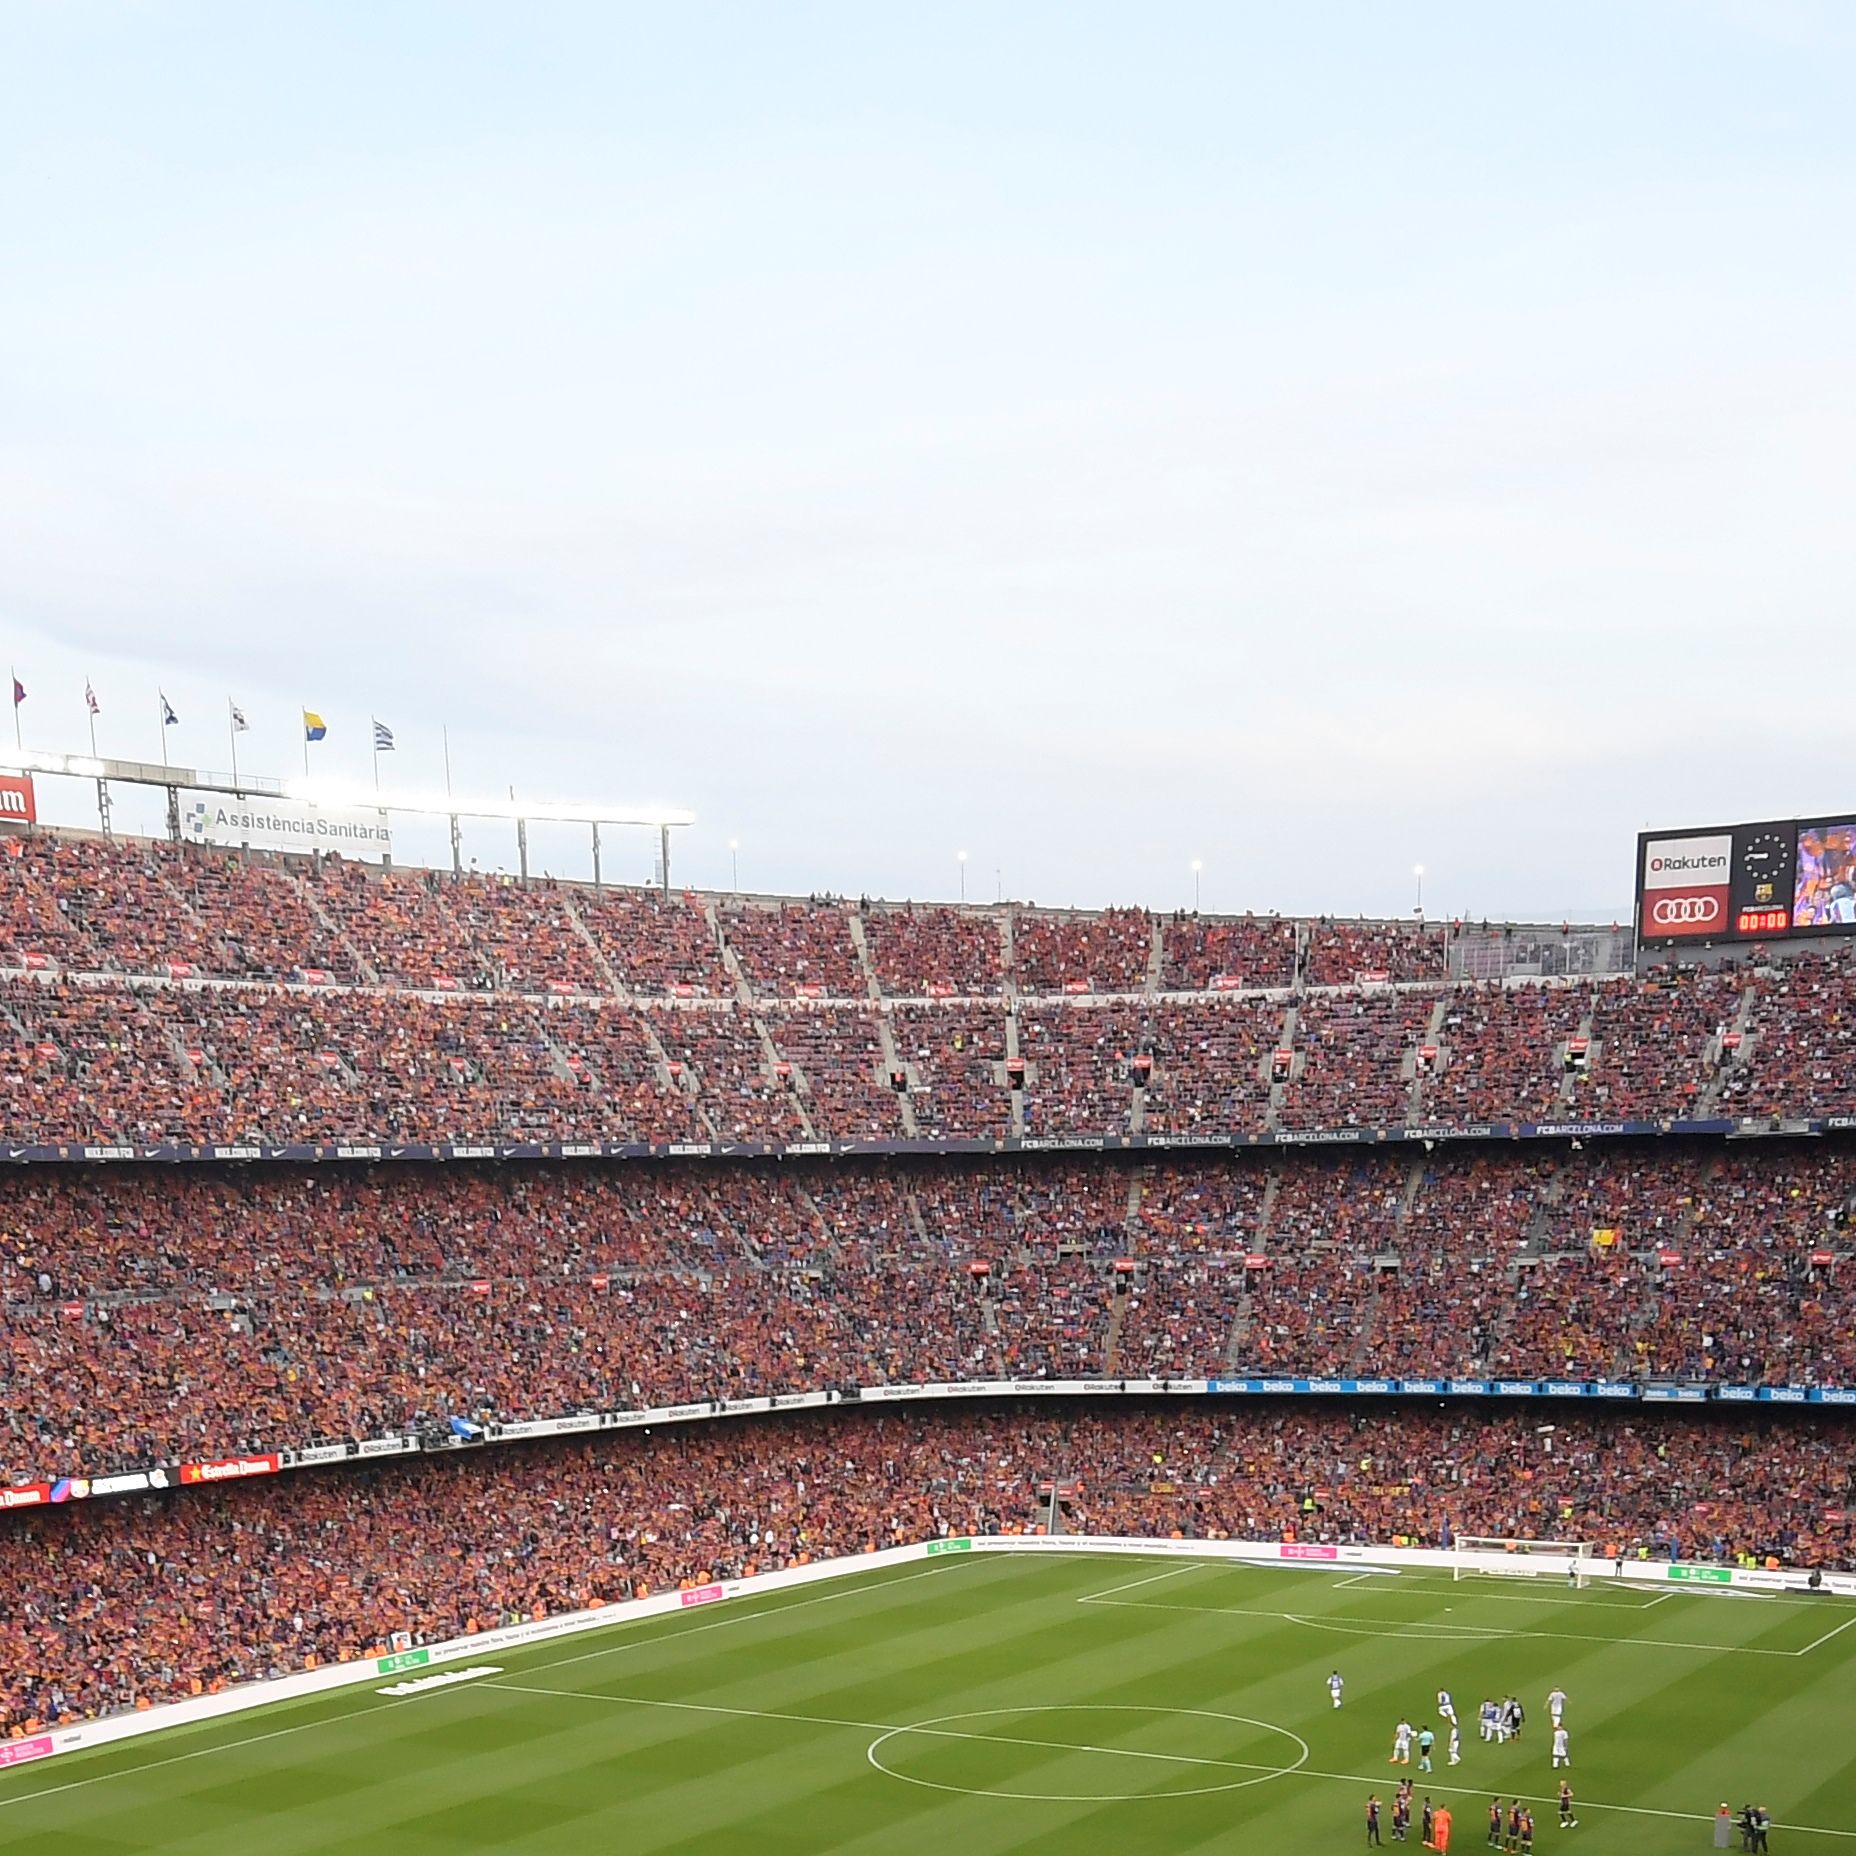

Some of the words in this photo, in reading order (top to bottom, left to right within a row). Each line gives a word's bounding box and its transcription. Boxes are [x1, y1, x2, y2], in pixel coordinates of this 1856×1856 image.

[215, 806, 315, 836] Assistència
[317, 814, 390, 842] Sanitària
[1663, 855, 1727, 871] Rakuten
[1739, 911, 1787, 931] 00:00
[1216, 1381, 1247, 1391] beko
[1263, 1381, 1293, 1391] beko
[1309, 1381, 1340, 1391] beko
[1356, 1381, 1387, 1391] beko
[1404, 1382, 1435, 1392] beko
[1452, 1382, 1483, 1392] beko
[1500, 1382, 1531, 1393] beko
[1549, 1383, 1581, 1394] beko
[1598, 1384, 1630, 1395] beko
[1720, 1387, 1753, 1399] beko
[1771, 1389, 1804, 1401] beko
[1822, 1390, 1855, 1402] beko
